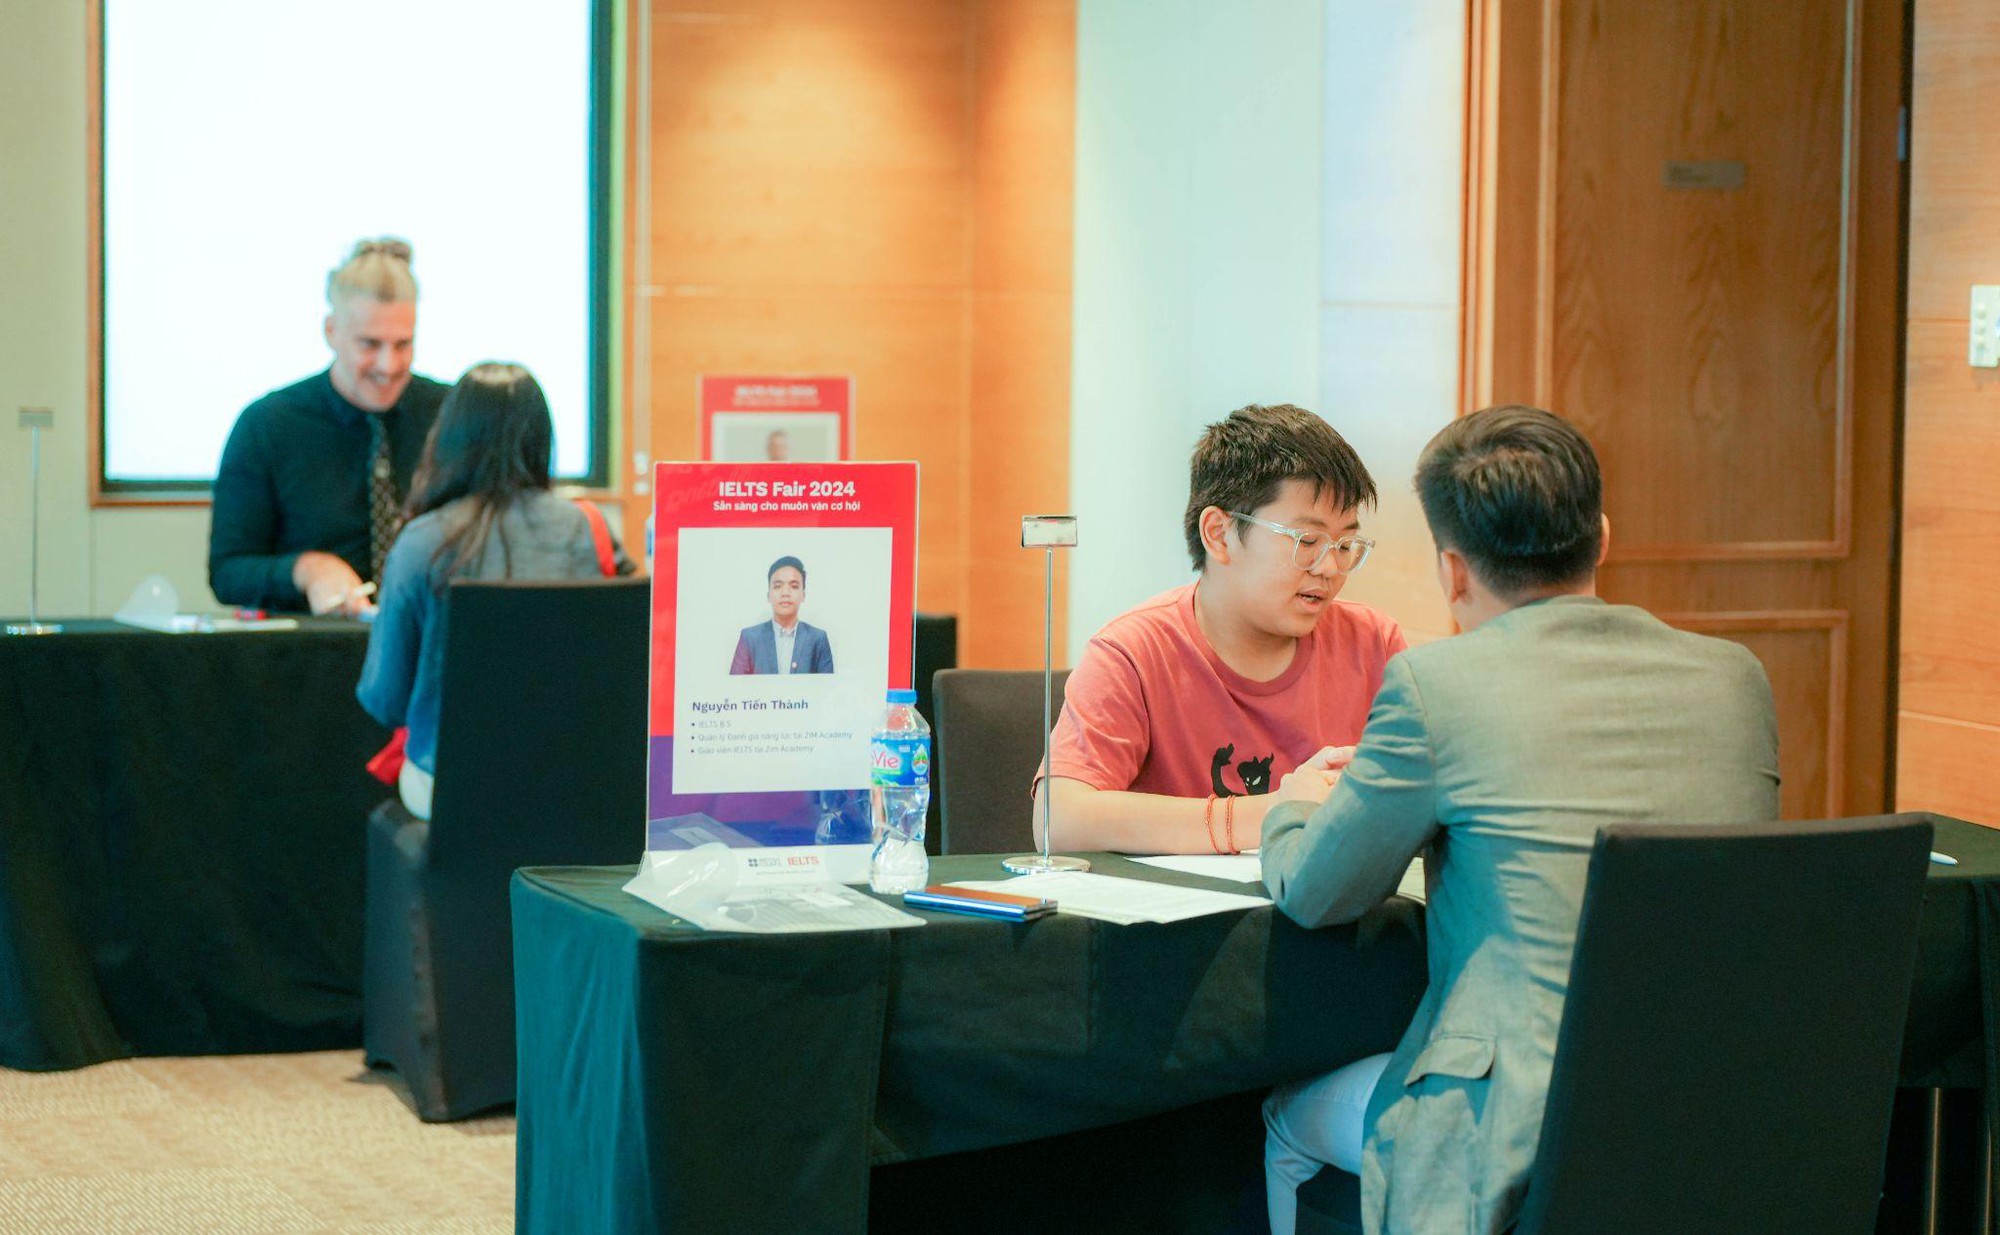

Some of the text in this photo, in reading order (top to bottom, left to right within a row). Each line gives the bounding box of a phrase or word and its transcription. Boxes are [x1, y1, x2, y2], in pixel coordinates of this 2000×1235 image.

[719, 481, 768, 497] IELTS
[772, 481, 806, 497] Fair
[809, 481, 856, 497] 2024
[734, 500, 758, 513] sàng
[760, 500, 778, 511] cho
[781, 501, 808, 511] muôn
[831, 502, 843, 511] cơ
[845, 501, 861, 512] hội
[692, 698, 738, 714] Nguyễn
[771, 698, 809, 710] Thành
[698, 720, 718, 729] IELTS
[819, 731, 853, 740] Academy
[733, 744, 753, 753] IELTS
[780, 743, 814, 754] Academy
[787, 856, 820, 867] IELTS
